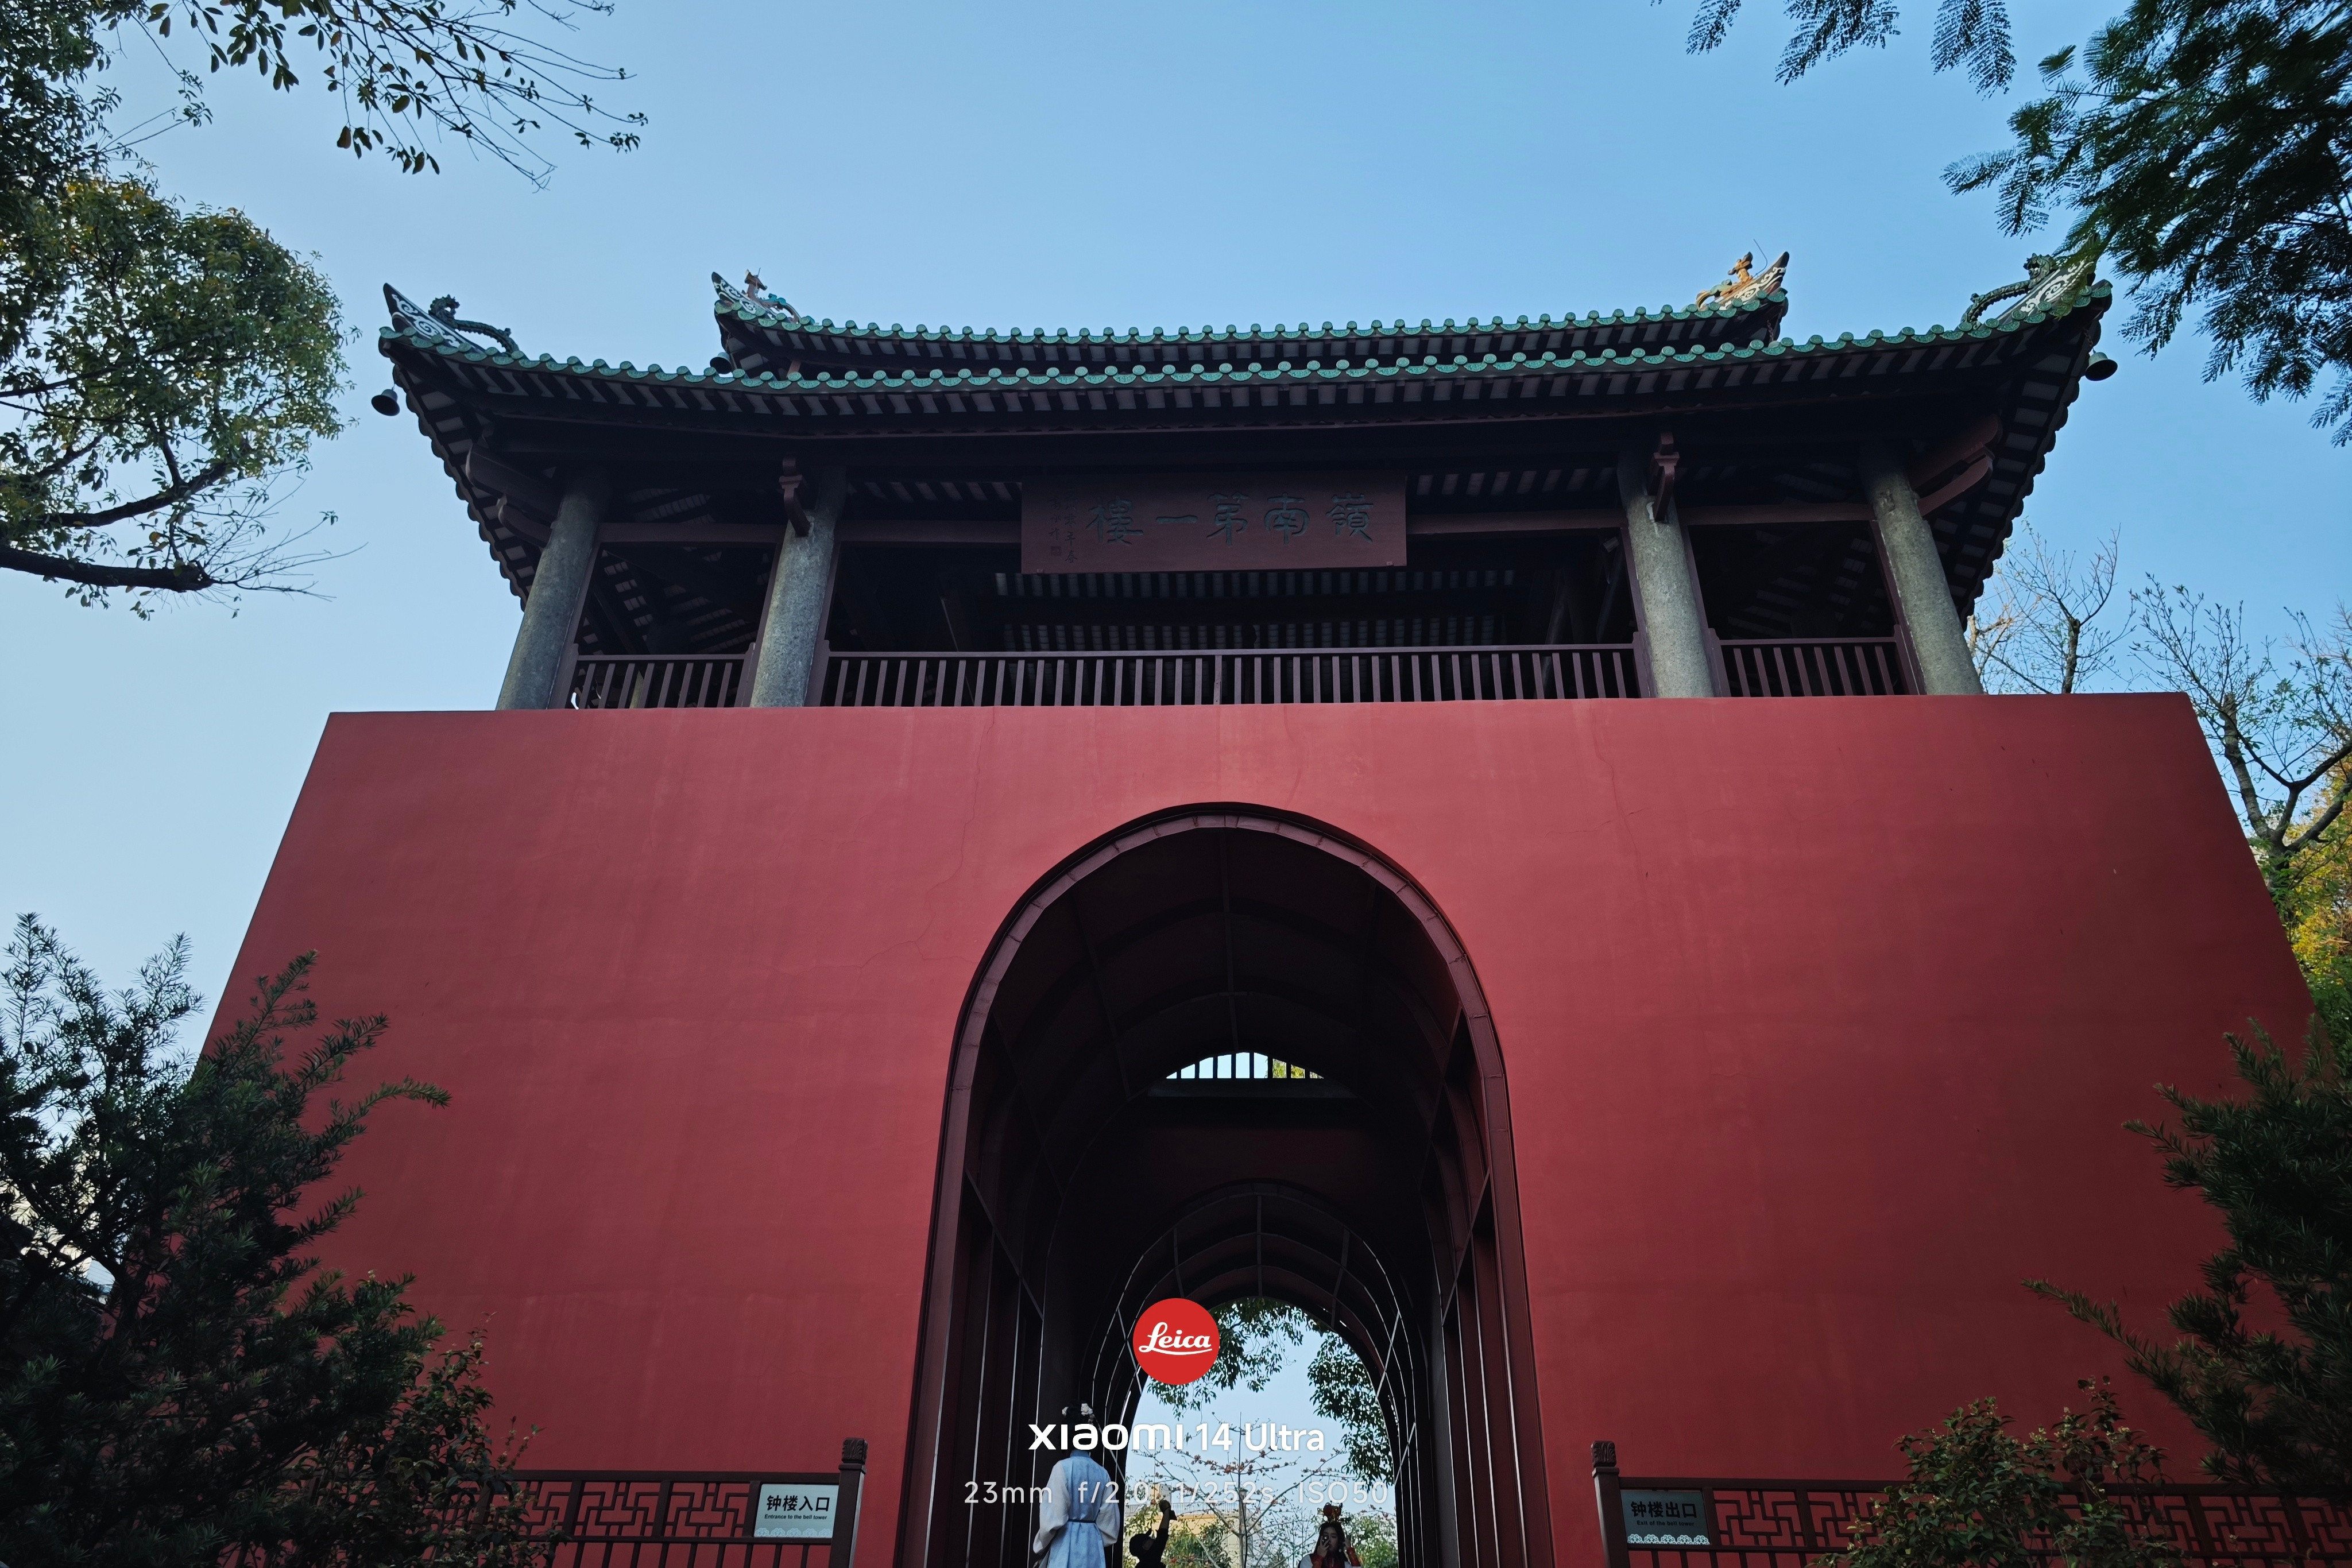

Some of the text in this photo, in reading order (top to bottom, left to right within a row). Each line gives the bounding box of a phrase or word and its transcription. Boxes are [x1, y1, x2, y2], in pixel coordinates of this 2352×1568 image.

[767, 1495, 830, 1512] 钟楼入口
[1630, 1501, 1697, 1519] 钟楼出口
